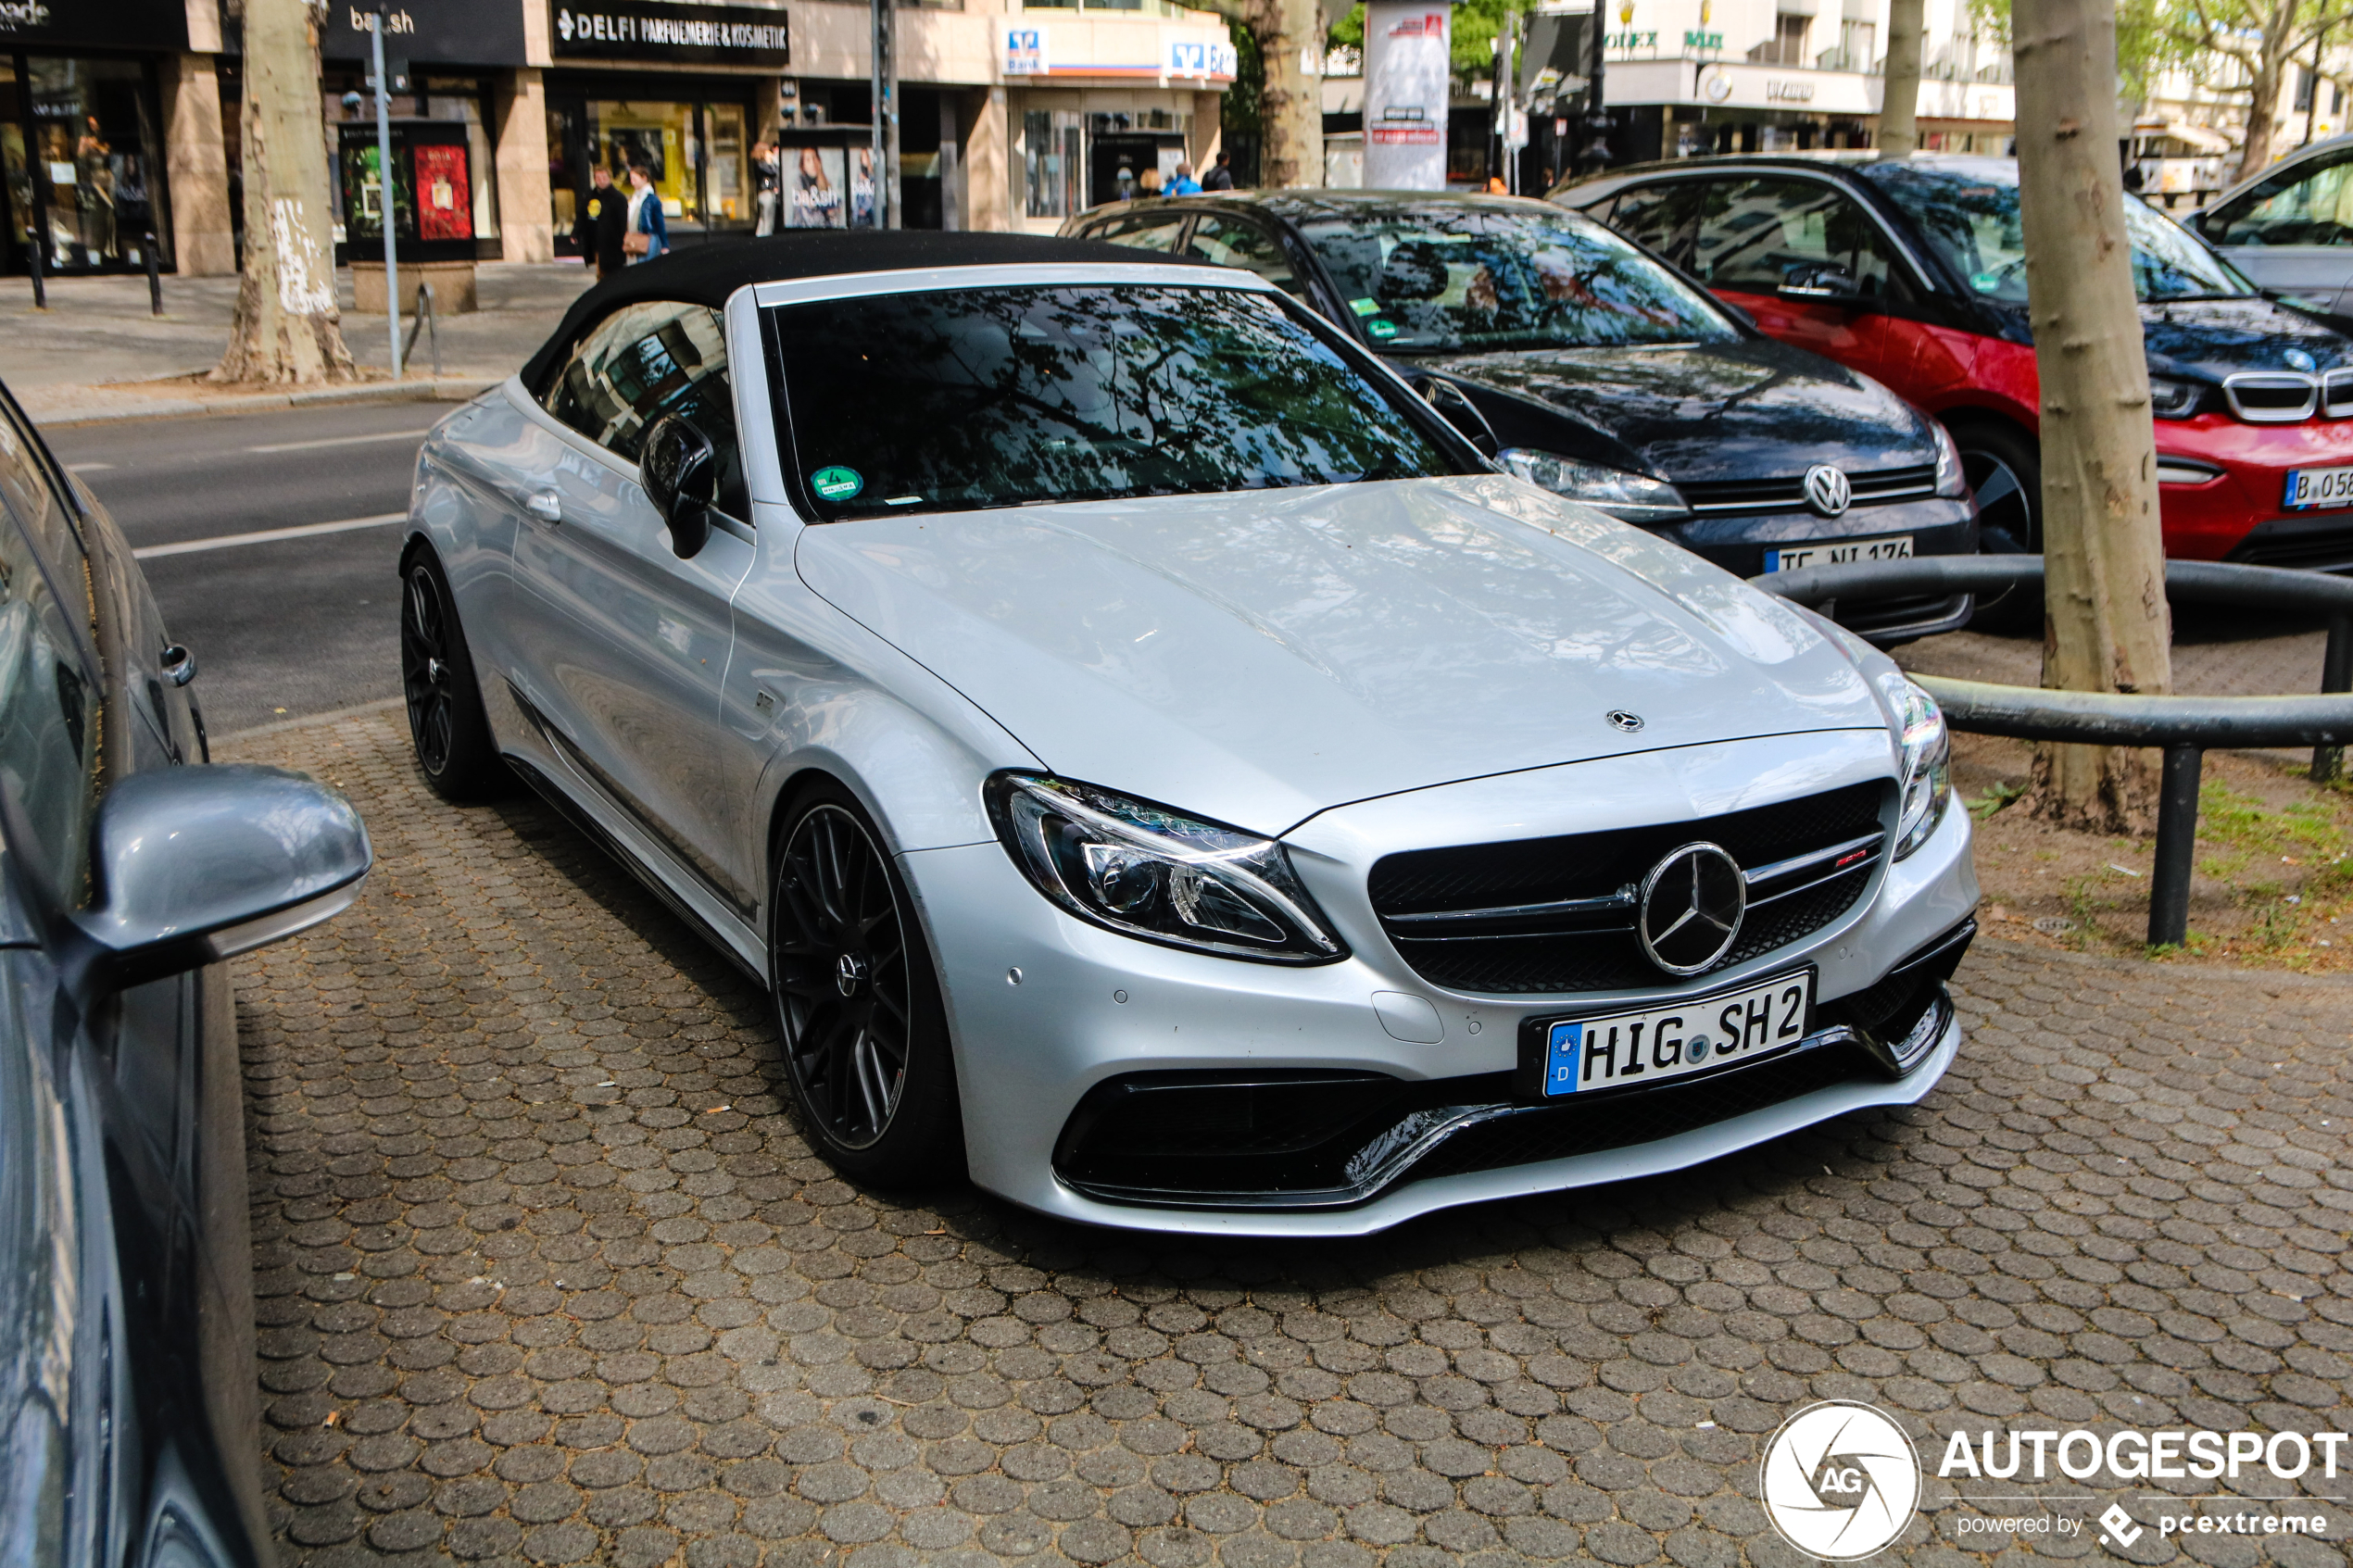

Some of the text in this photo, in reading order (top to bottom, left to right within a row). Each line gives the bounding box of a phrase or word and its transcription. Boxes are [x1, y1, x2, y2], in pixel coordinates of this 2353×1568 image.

[350, 6, 414, 34] bash
[576, 13, 636, 42] DELFI
[731, 23, 786, 50] KOSMETIK
[1604, 31, 1657, 49] OLEX
[1009, 59, 1040, 73] Bank
[792, 185, 838, 207] ba&sh
[829, 470, 841, 483] 4
[1557, 1066, 1570, 1082] D
[1582, 1016, 1684, 1082] HIG
[1715, 993, 1772, 1056] SH
